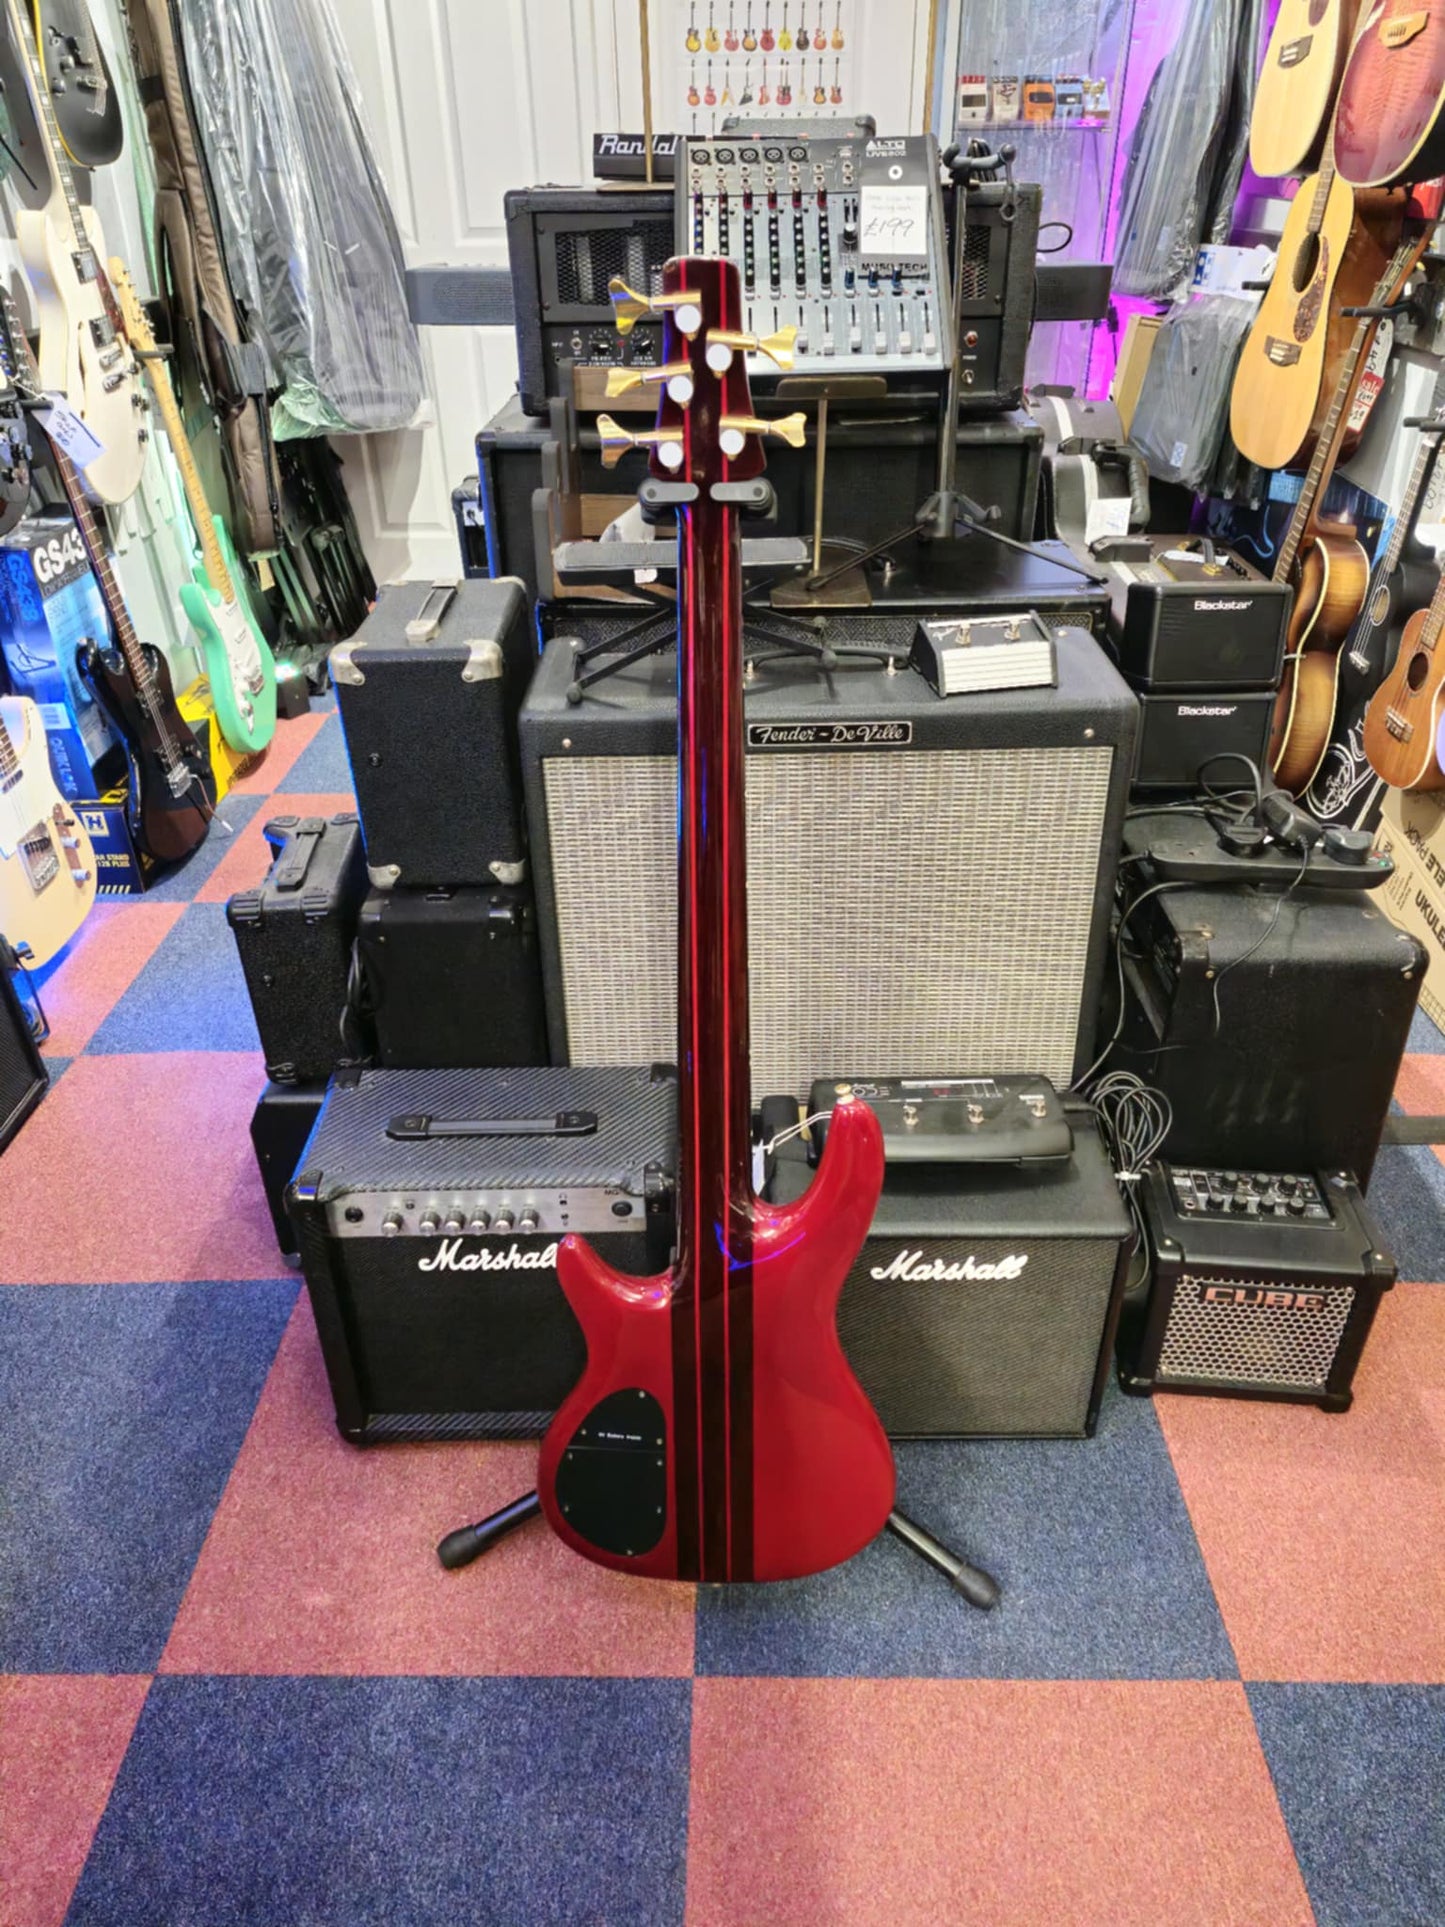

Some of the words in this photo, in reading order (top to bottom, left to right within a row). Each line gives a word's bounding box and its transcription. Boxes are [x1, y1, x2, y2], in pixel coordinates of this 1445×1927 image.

[866, 140, 906, 151] ALTO
[863, 217, 915, 237] £199
[898, 263, 928, 272] TECH
[33, 527, 87, 583] GS43
[1194, 600, 1253, 610] Blackstar
[1178, 705, 1237, 716] Blackstar
[756, 726, 817, 744] Fender
[870, 1249, 1029, 1281] Marshall
[1205, 1287, 1324, 1310] CUBE
